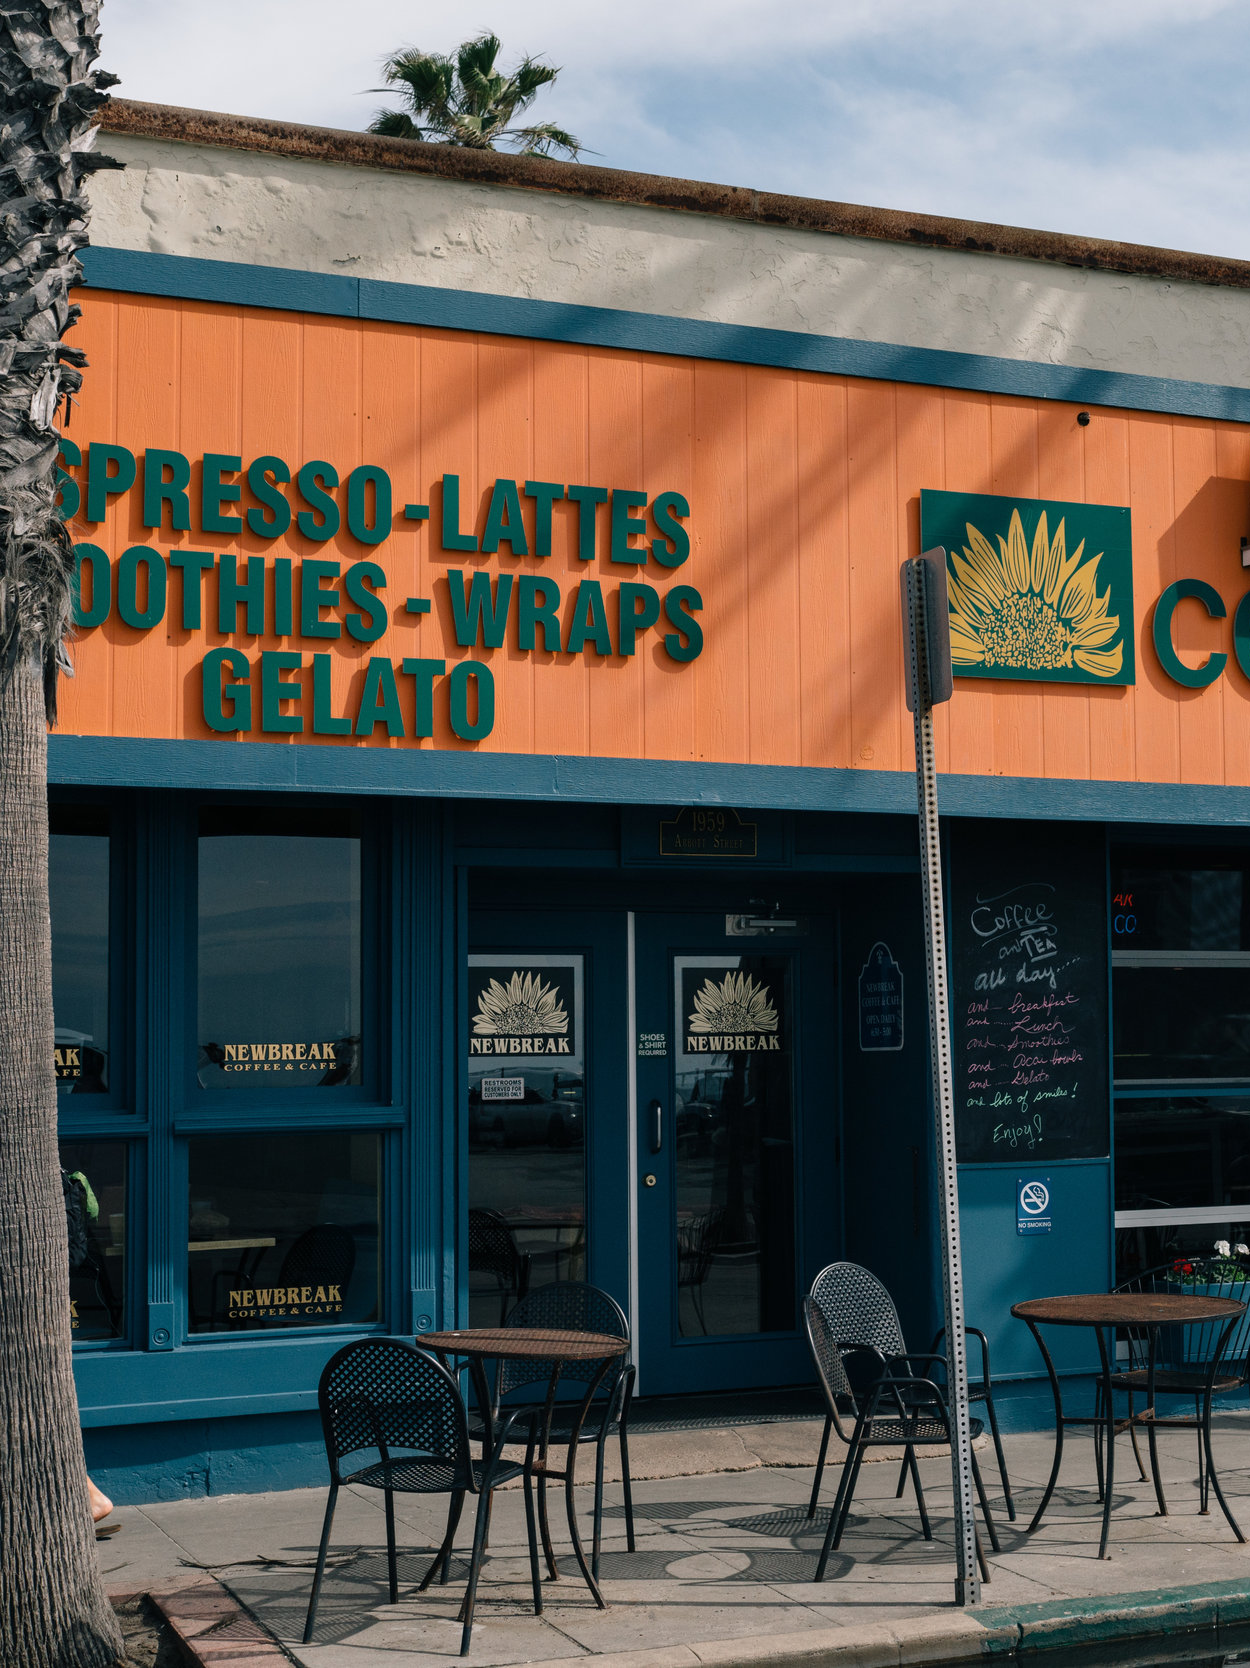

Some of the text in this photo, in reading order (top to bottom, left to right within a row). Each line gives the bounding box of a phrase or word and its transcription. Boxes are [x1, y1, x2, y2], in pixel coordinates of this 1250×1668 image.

[441, 473, 691, 569] LATTES
[448, 569, 703, 662] WRAPS
[201, 647, 496, 741] GELATO
[691, 811, 725, 832] 1959
[974, 967, 1006, 991] all
[968, 998, 989, 1014] and
[470, 1037, 570, 1054] NEWBREAK
[640, 1033, 665, 1041] SHOES
[644, 1041, 666, 1049] SHIRT
[687, 1035, 780, 1052] NEWBREAK
[224, 1042, 336, 1061] NEWBREAK
[224, 1061, 337, 1072] COFFEE & CAFE
[990, 1091, 1012, 1107] lots
[1017, 1090, 1028, 1112] of
[1027, 1221, 1051, 1229] SMOKING
[229, 1285, 342, 1308] NEWBREAK
[229, 1304, 343, 1318] COFFEE & CAFE
